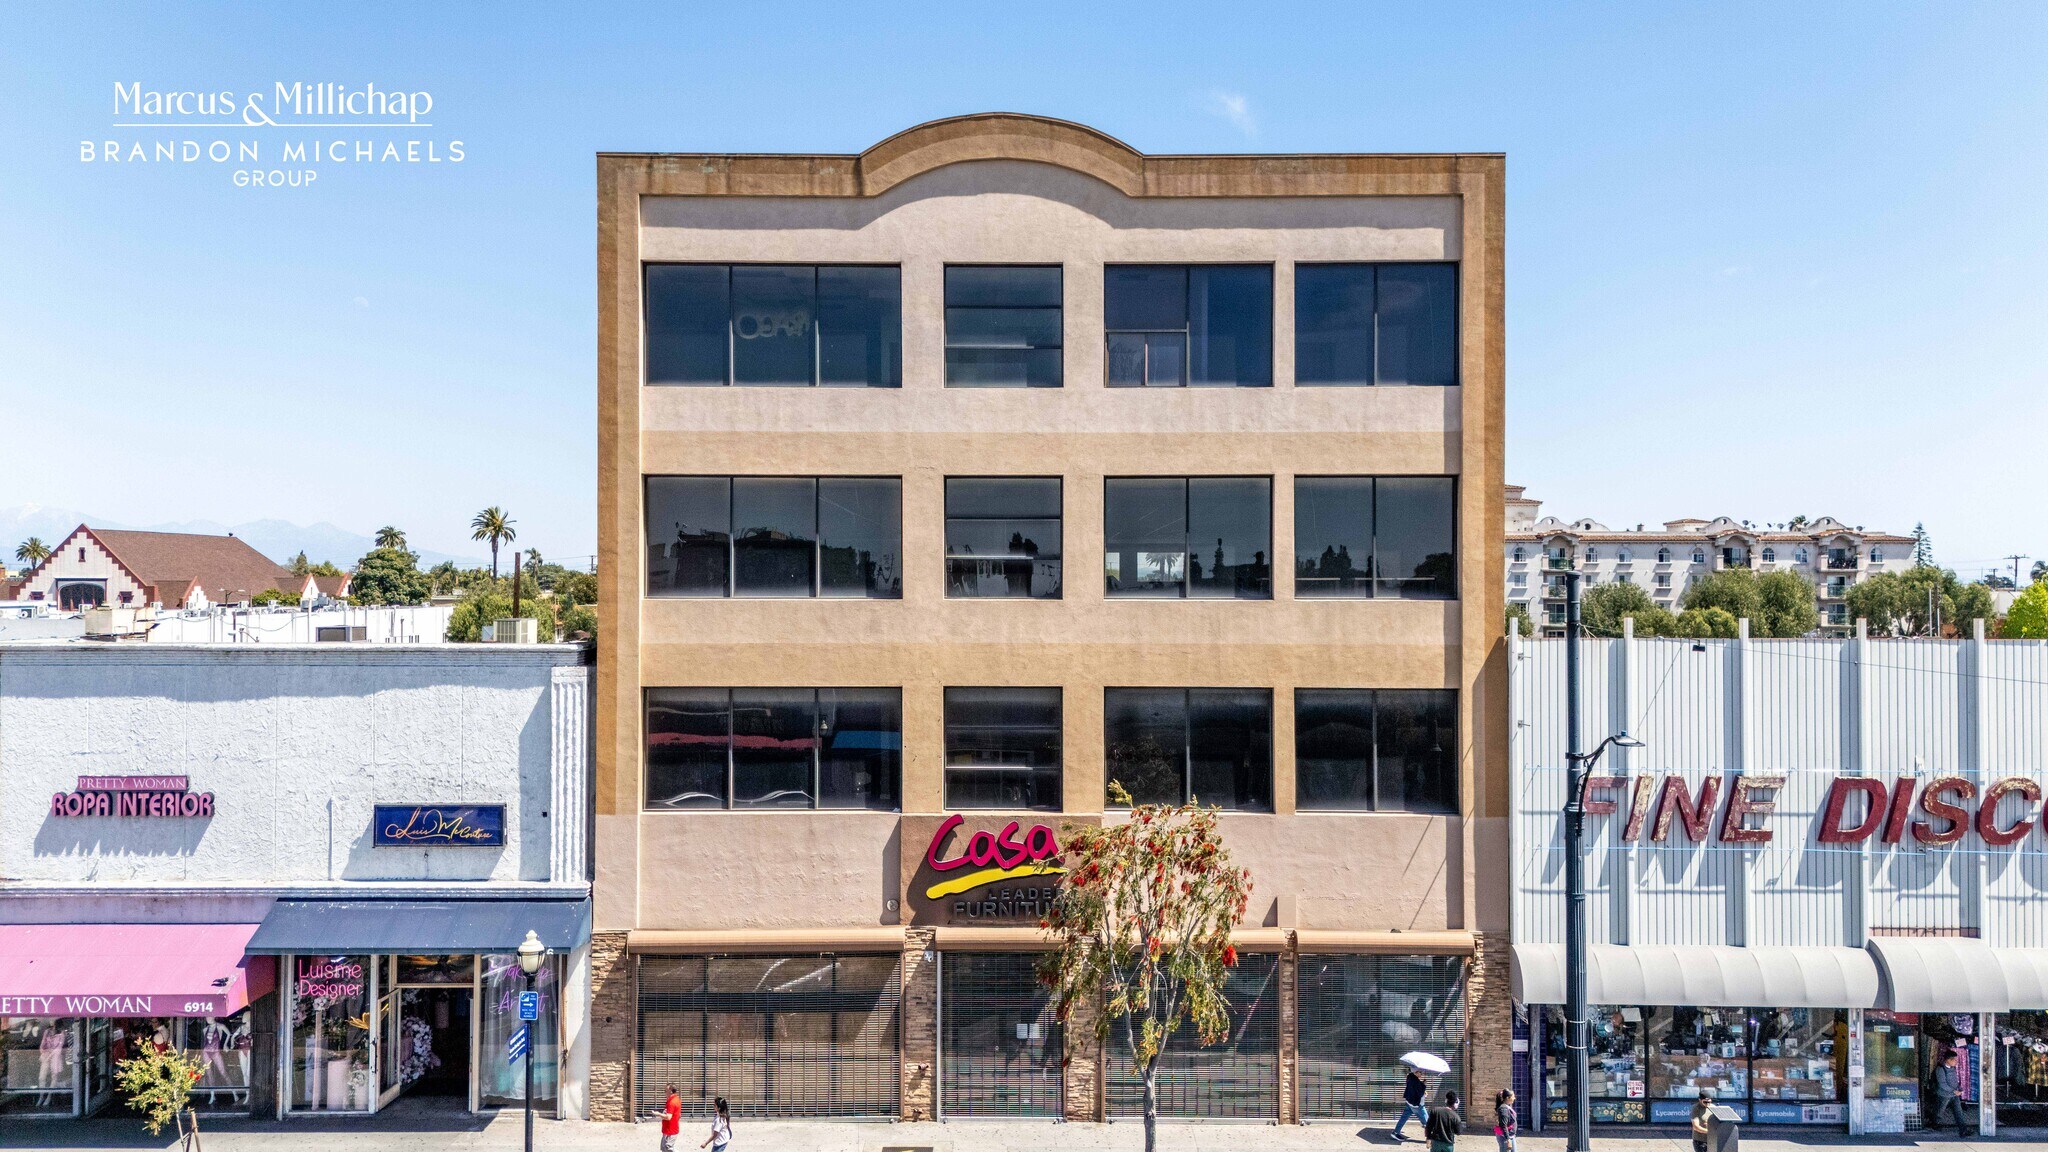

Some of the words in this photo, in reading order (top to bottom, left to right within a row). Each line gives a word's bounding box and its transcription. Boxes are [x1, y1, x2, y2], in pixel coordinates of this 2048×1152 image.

[79, 777, 127, 789] PRETTY
[133, 777, 186, 789] WOMAN
[51, 792, 112, 817] ROPA
[117, 792, 213, 817] INTERIOR
[1582, 774, 1786, 842] FINE
[1818, 776, 2048, 846] DISC
[928, 814, 1066, 871] Casa
[952, 901, 1066, 918] FURNITU
[299, 959, 362, 979] Luisme
[299, 979, 362, 1000] Designer
[0, 996, 54, 1014] ETTY
[65, 996, 151, 1014] WOMAN
[184, 1002, 214, 1012] 6914
[1655, 1109, 1691, 1117] Lycamobil
